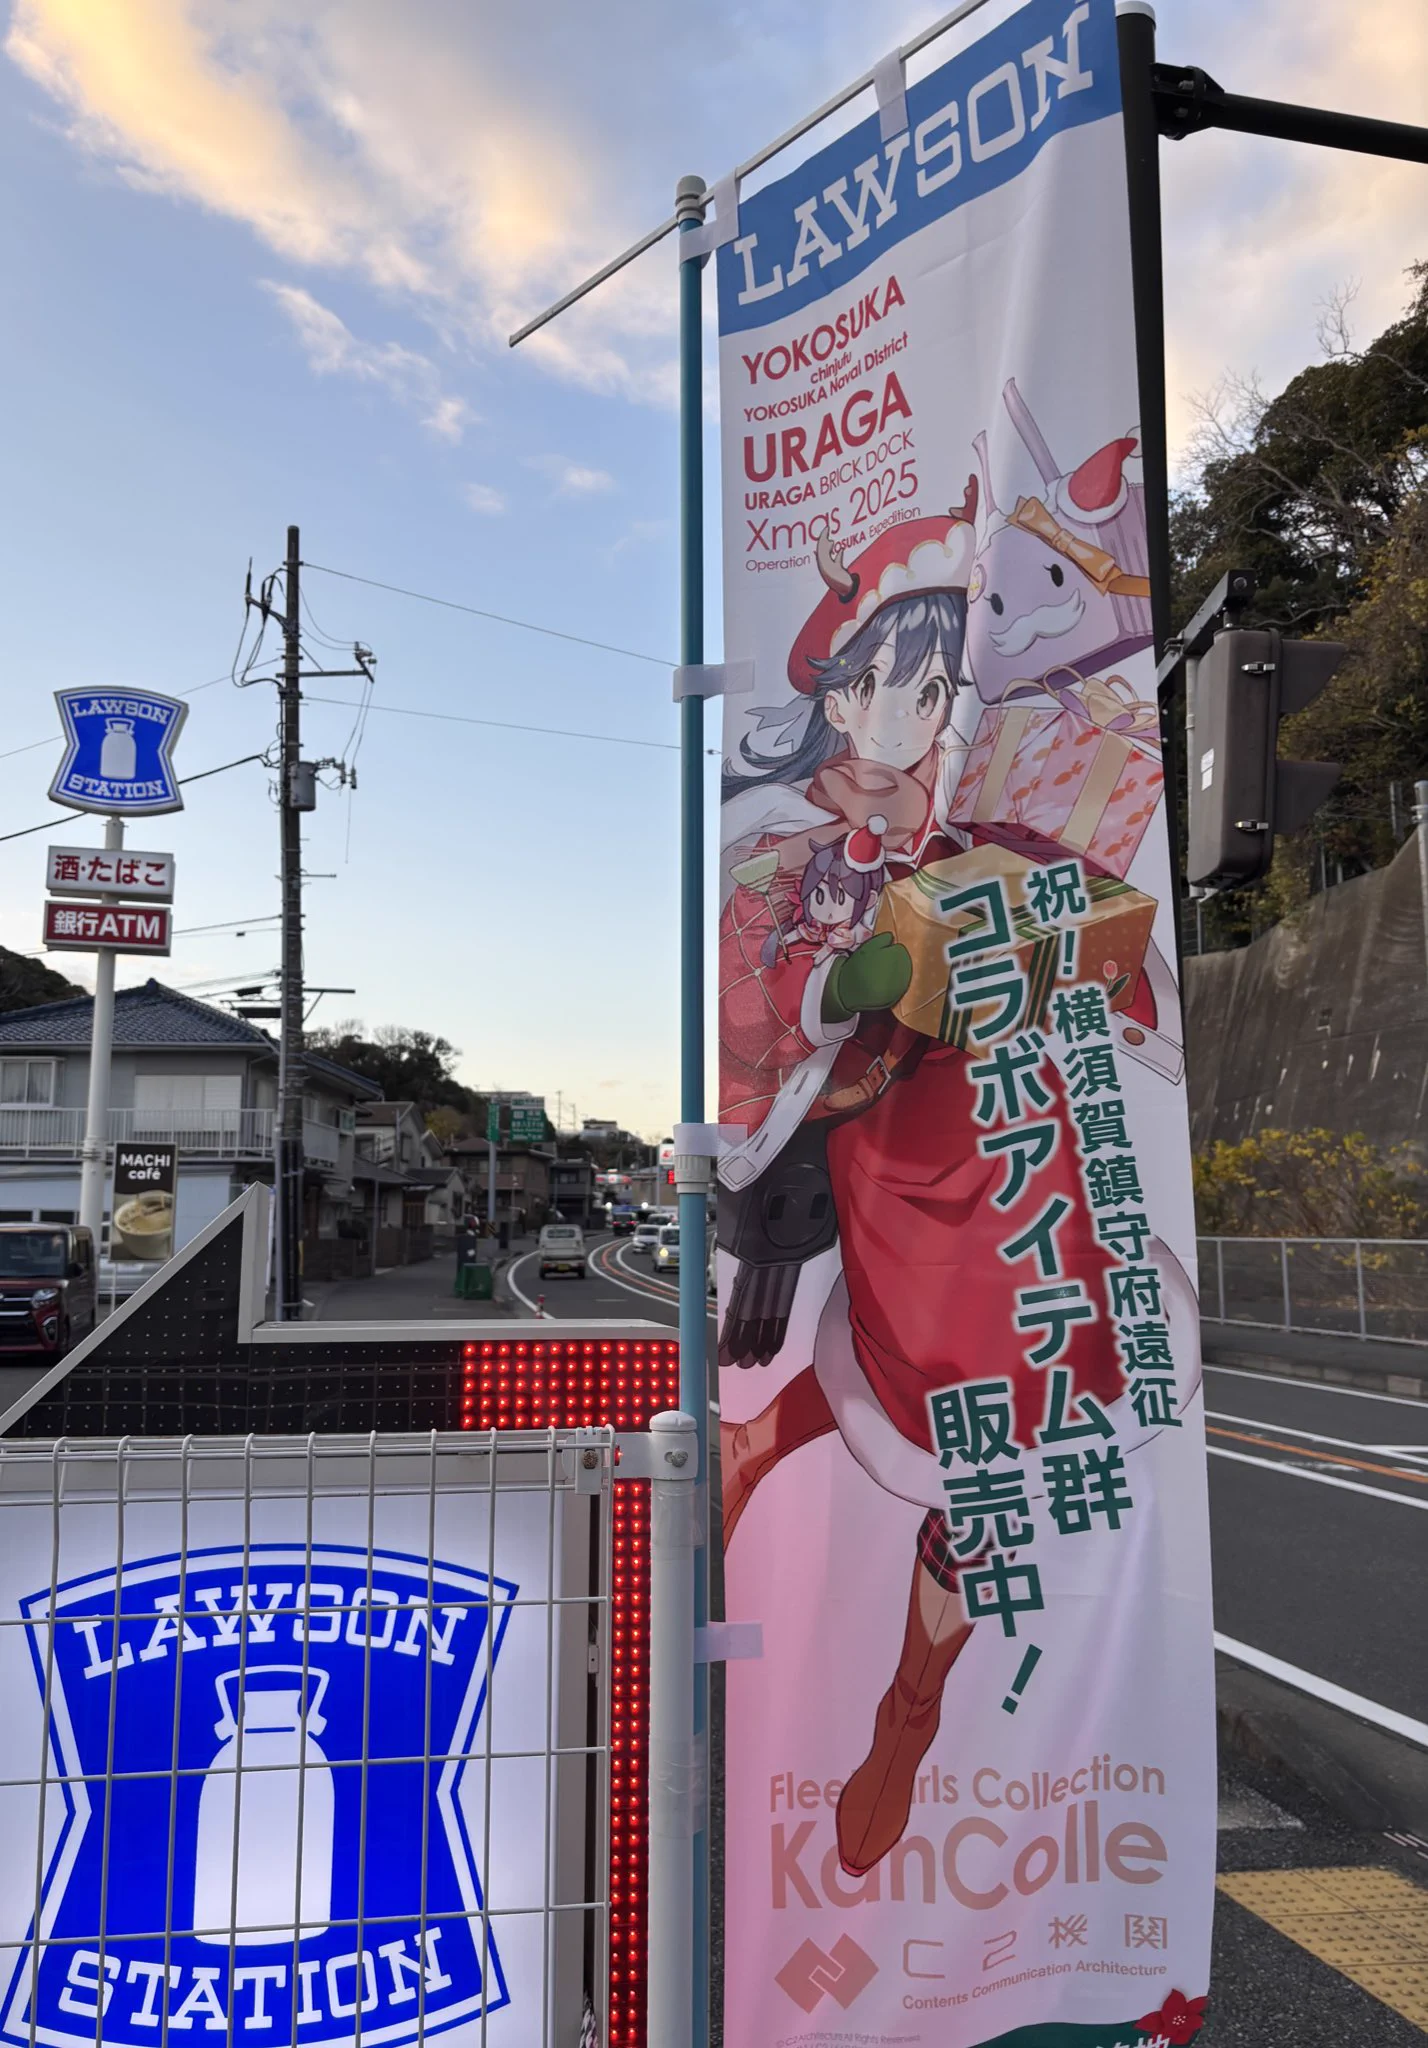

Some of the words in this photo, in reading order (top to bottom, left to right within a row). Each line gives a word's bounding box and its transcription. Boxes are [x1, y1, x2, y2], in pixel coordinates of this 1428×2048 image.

[733, 2, 1094, 306] LAWSON
[741, 275, 906, 385] YOKOSUKA
[810, 351, 852, 384] chinjufu
[743, 386, 828, 422] YOKOSUKA
[829, 361, 862, 396] Naval
[864, 331, 908, 372] District
[742, 371, 913, 483] URAGA
[744, 481, 816, 510] URAGA
[819, 456, 863, 495] BRICK
[865, 428, 915, 472] DOCK
[745, 507, 841, 552] Xmas
[849, 459, 919, 526] 2025
[745, 555, 811, 573] Operation
[868, 506, 921, 538] Expedition
[71, 699, 171, 725] LAWSON
[67, 773, 166, 798] STATION
[54, 854, 166, 886] 酒・たばこ
[53, 910, 160, 939] 銀行ATM
[120, 1153, 171, 1167] MACHI
[128, 1167, 161, 1180] café
[940, 880, 1134, 1536] コラボアイテム群
[930, 1380, 1045, 1715] 販売中！
[73, 1582, 468, 1679] LAWSON
[770, 1769, 857, 1813] Flee
[972, 1753, 1165, 1811] Collection
[770, 1800, 1168, 1911] KanColle
[58, 1927, 453, 2031] STATION
[902, 1993, 968, 2010] Contents
[972, 1963, 1071, 1999] Communication
[1075, 1959, 1167, 1976] Architecture
